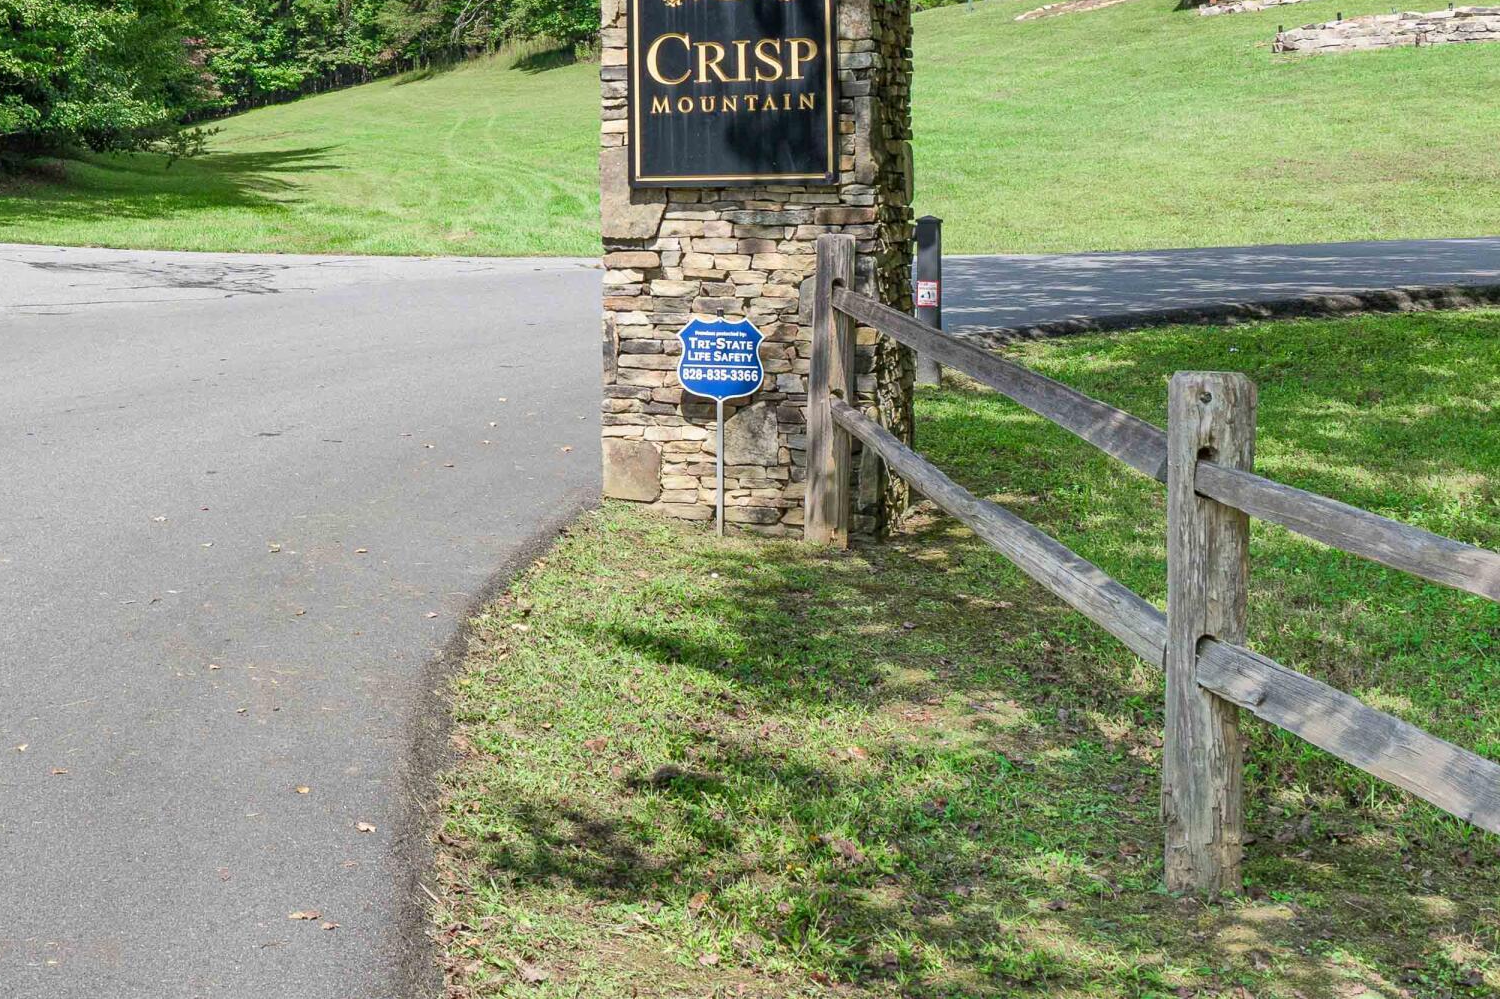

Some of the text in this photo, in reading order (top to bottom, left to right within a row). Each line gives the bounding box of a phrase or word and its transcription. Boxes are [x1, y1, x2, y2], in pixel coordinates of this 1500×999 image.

[646, 32, 818, 85] CRISP
[650, 92, 815, 114] MOUNTAIN
[688, 337, 754, 350] TRI-STATE
[687, 350, 753, 363] LIFE SAFETY
[682, 368, 759, 382] 828-835-3366
